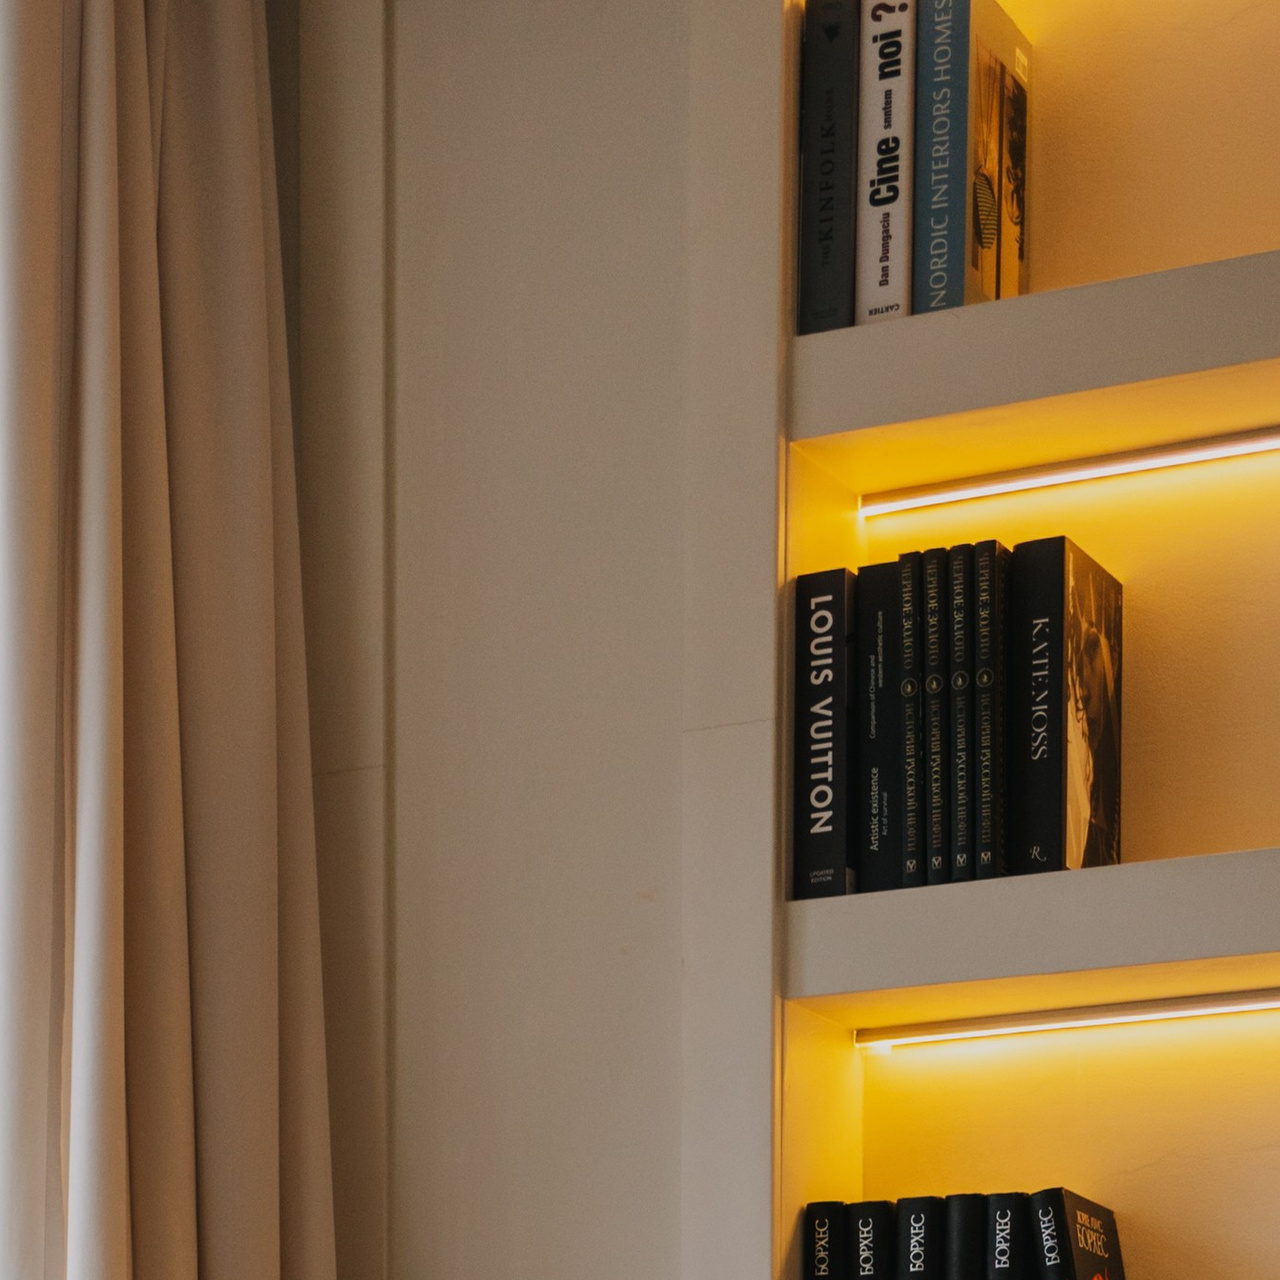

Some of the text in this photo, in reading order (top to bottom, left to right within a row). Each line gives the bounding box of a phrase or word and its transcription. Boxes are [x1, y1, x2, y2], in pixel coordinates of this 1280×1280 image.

[871, 2, 908, 22] ?
[872, 29, 902, 82] noi
[869, 135, 900, 208] Cine
[929, 0, 952, 308] NORDIC INTERIORS HOMES
[818, 122, 835, 243] KINFOLK
[878, 211, 892, 287] Dan Dungaciu
[868, 303, 900, 316] CARTIER
[902, 616, 913, 669] ЗОЛОТО
[927, 613, 939, 666] ЗОЛОТО
[953, 609, 965, 662] ЗОЛОТО
[978, 606, 990, 660] ЗОЛОТО
[809, 594, 834, 834] LOUIS VUITTON
[1031, 617, 1049, 760] KATE MOSS
[904, 758, 917, 811] РУССКОЙ
[930, 754, 943, 807] РУССКОЙ
[955, 751, 968, 804] РУССКОЙ
[979, 749, 993, 802] РУССКОЙ
[870, 767, 879, 851] Artistic existence
[809, 868, 834, 878] UPDATED
[810, 876, 833, 884] EDITION
[815, 1218, 829, 1276] БОРХЕС
[858, 1217, 874, 1276] БОРХЕС
[909, 1213, 925, 1272] БОРХЕС
[995, 1209, 1011, 1268] БОРХЕС
[1038, 1206, 1060, 1266] БОРХЕС
[1076, 1224, 1109, 1258] БОРХЕС
